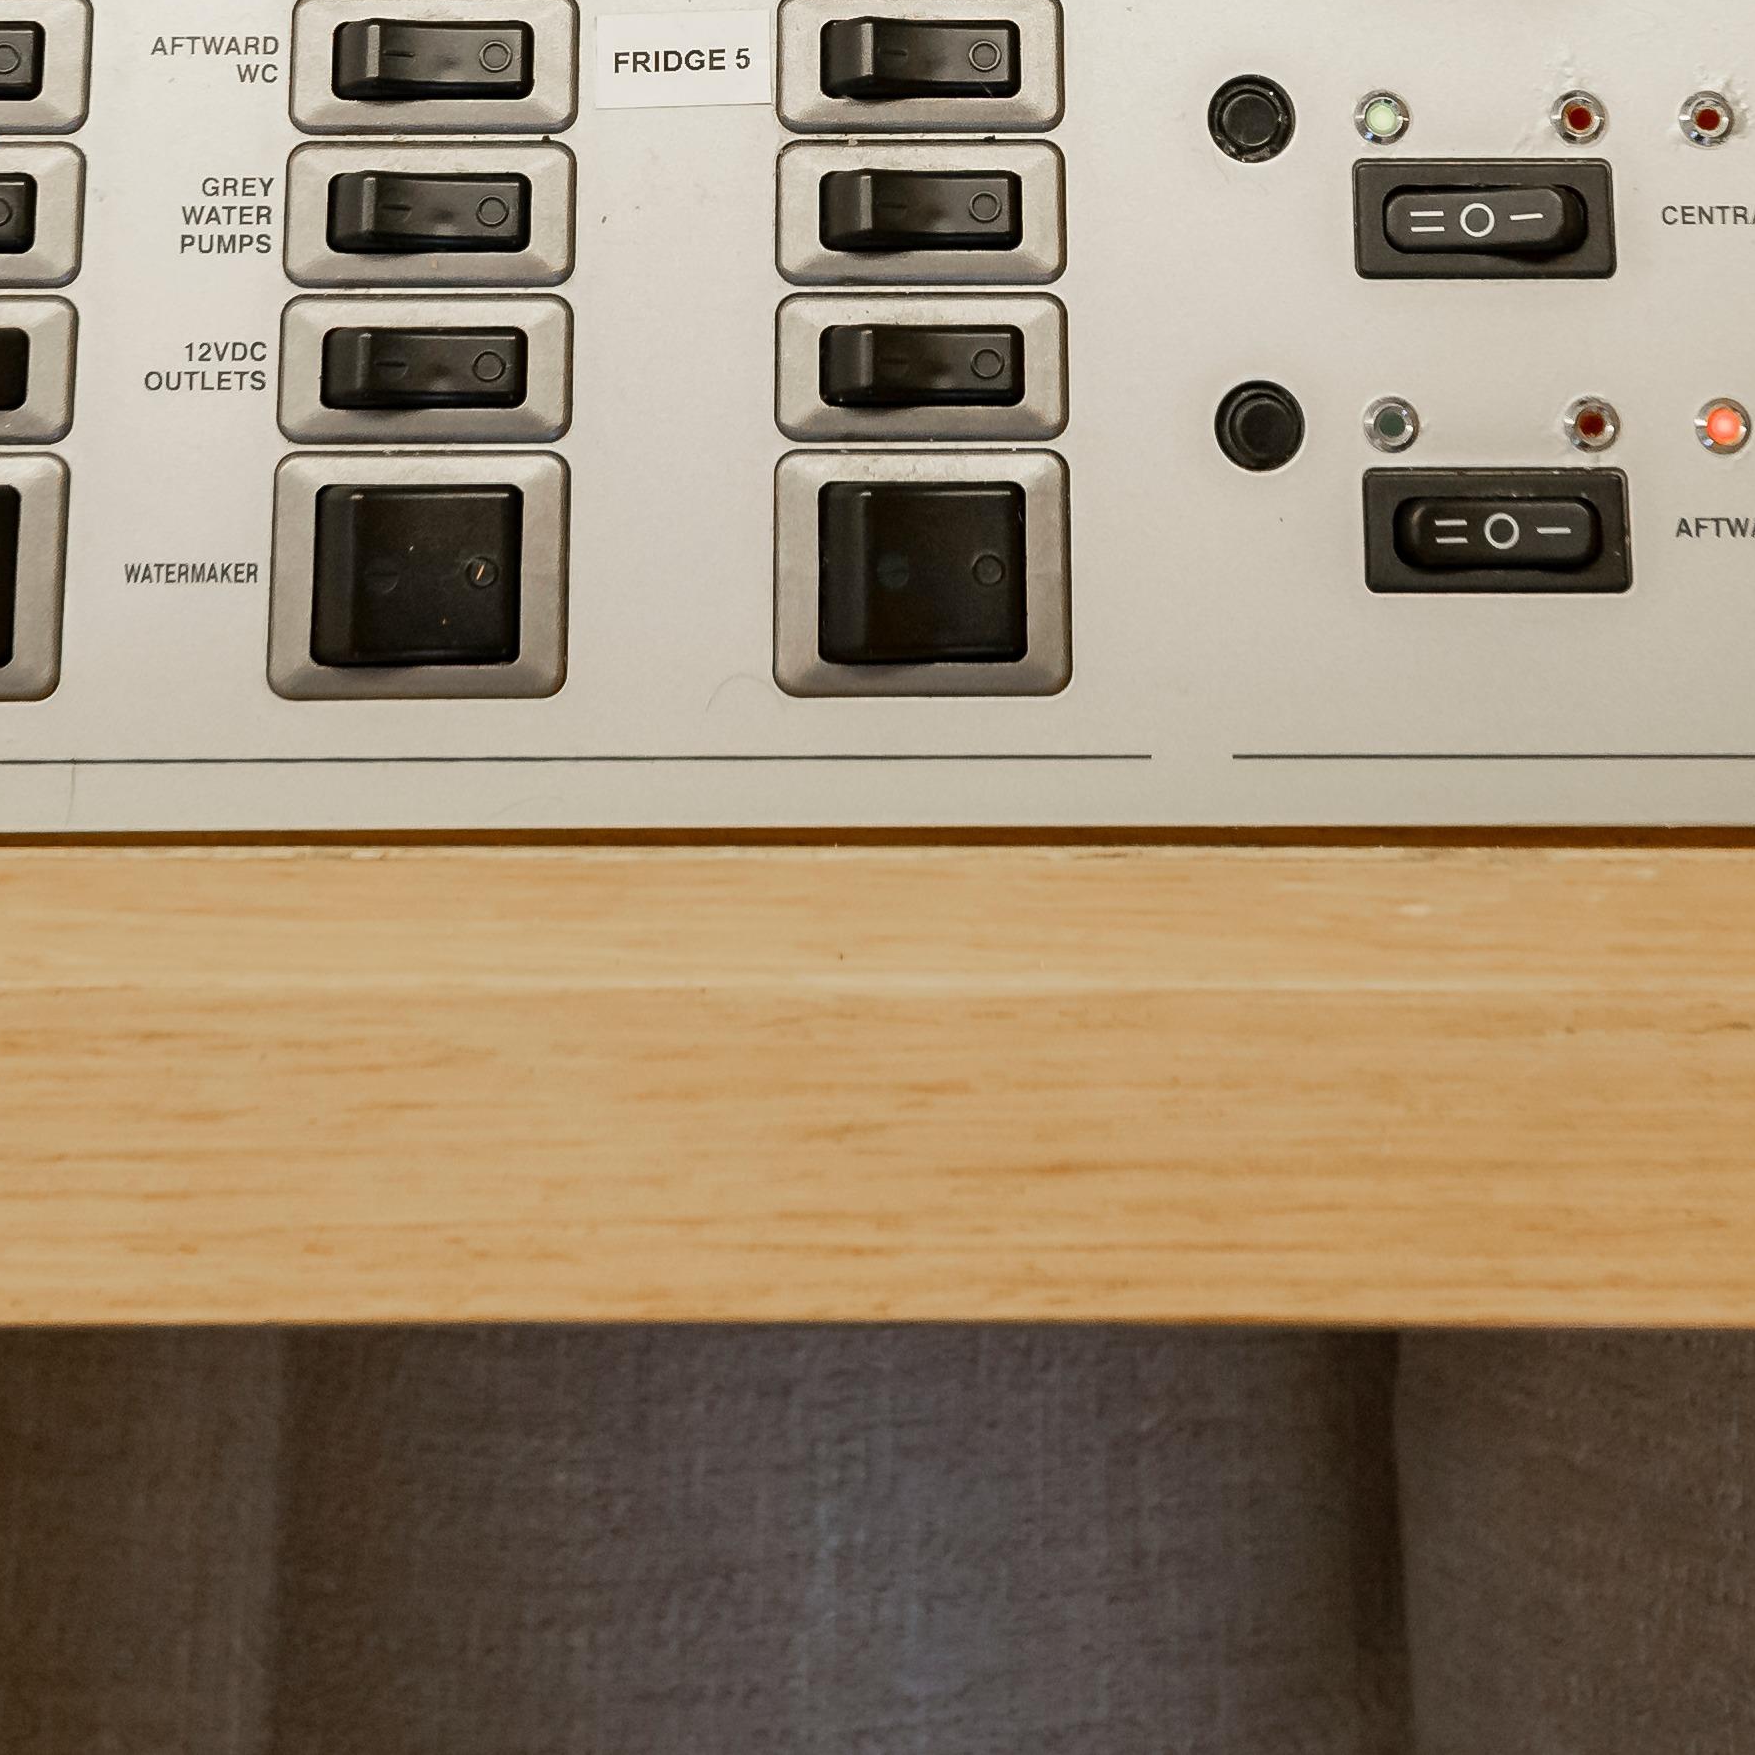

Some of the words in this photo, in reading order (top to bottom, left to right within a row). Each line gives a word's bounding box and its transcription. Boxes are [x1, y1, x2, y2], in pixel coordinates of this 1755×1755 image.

[150, 35, 280, 56] AFTWARD
[614, 48, 726, 74] FRIDGE
[735, 47, 751, 70] 5
[236, 63, 279, 84] WC
[201, 177, 275, 198] GREY
[181, 205, 273, 226] WATER
[180, 233, 272, 254] PUMPS
[184, 341, 268, 362] 12VDC
[144, 369, 267, 391] OUTLETS
[124, 562, 259, 584] WATERMAKER
